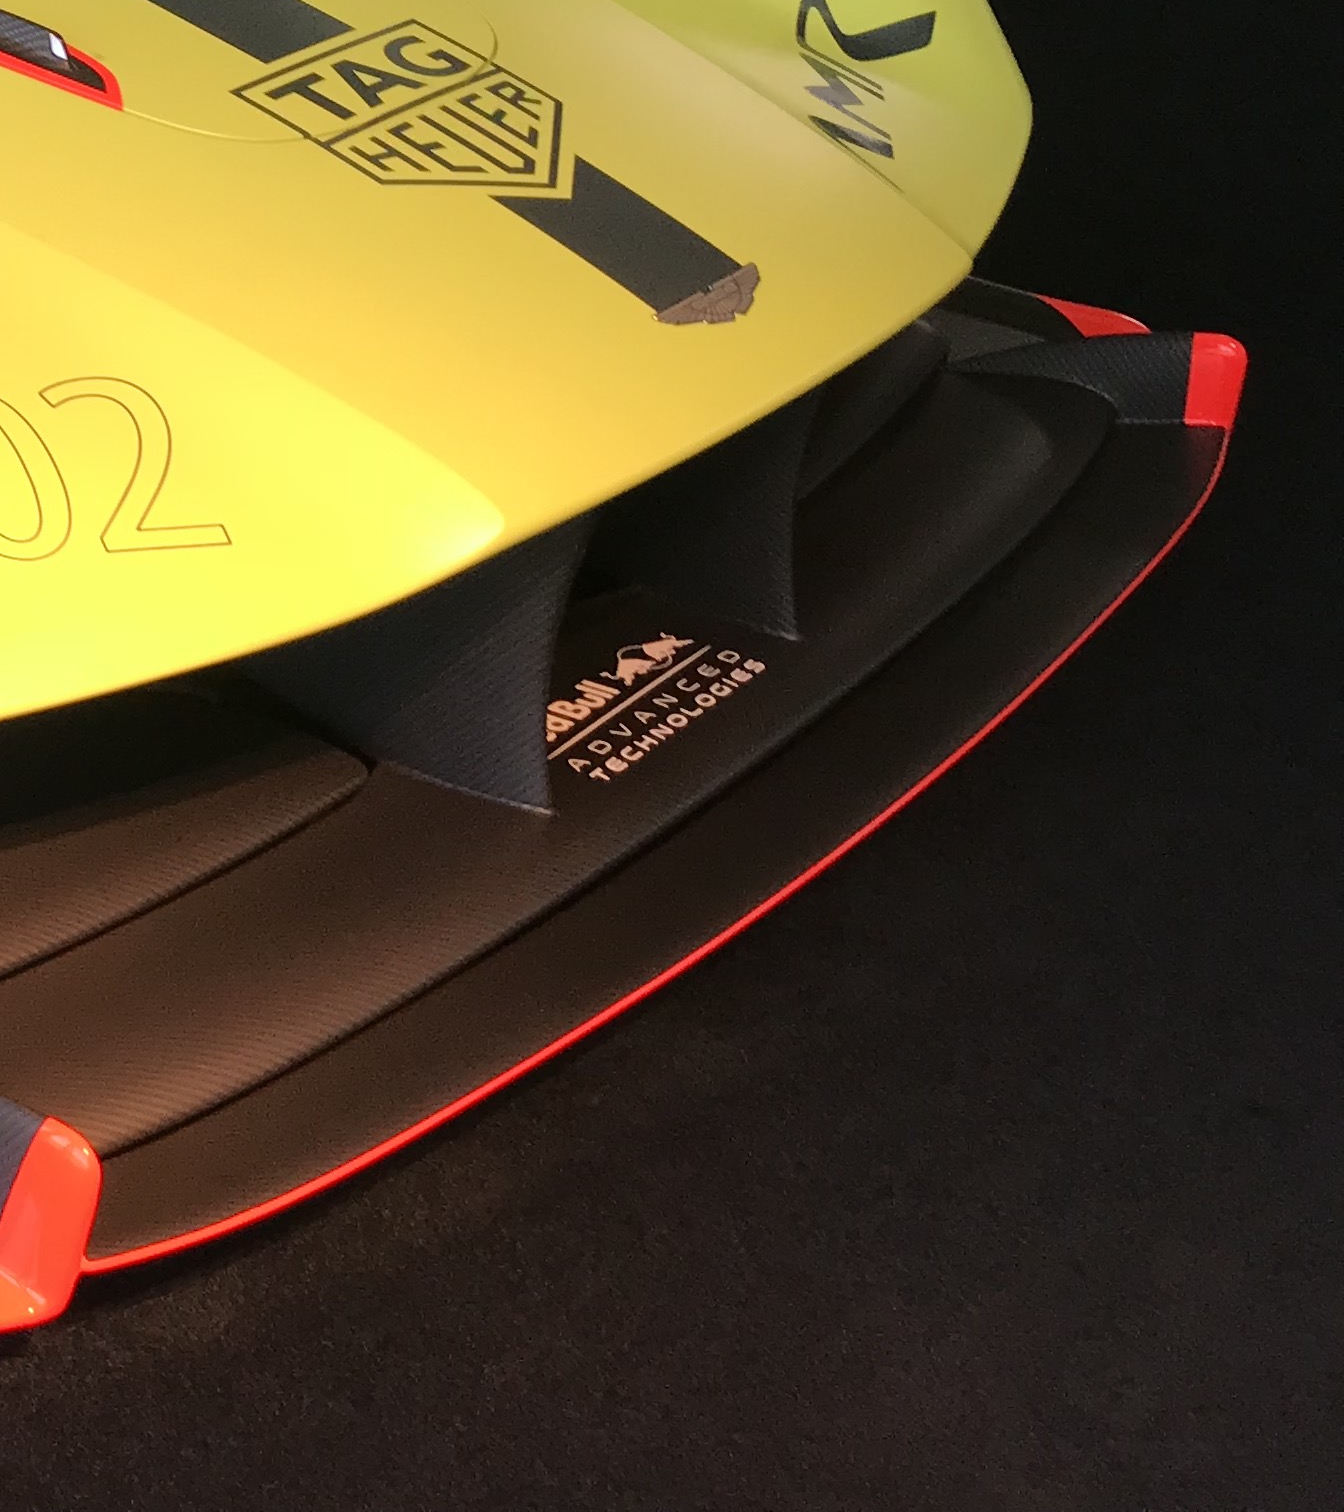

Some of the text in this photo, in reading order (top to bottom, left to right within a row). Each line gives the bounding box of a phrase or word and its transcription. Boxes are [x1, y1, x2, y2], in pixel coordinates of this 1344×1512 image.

[264, 36, 472, 120] TAG
[349, 80, 542, 175] HEUER
[567, 649, 741, 773] ADVANCED
[588, 658, 766, 781] TECHNOLOGIES
